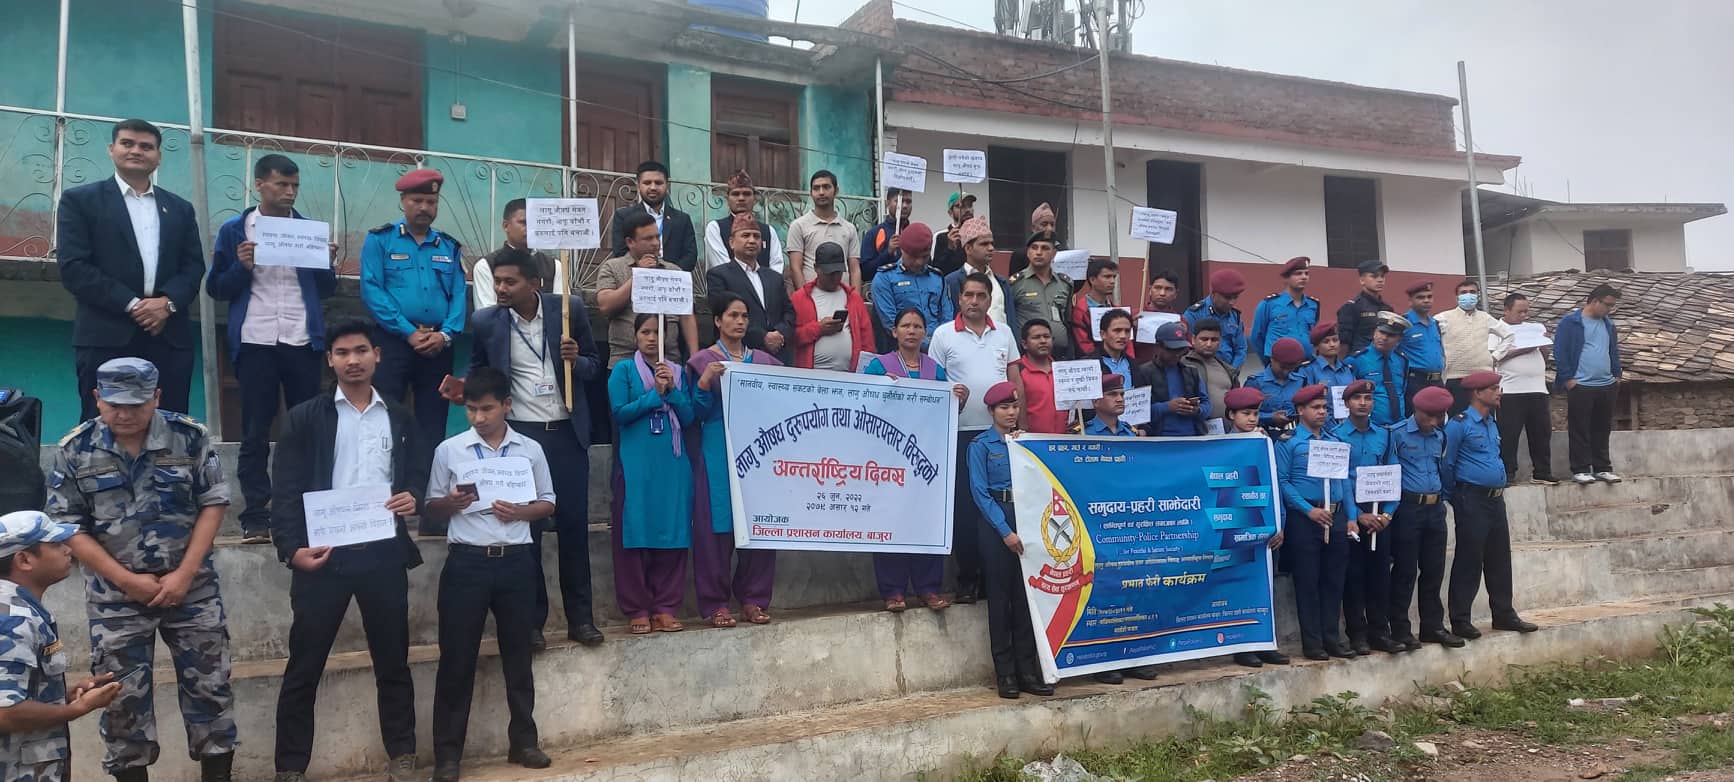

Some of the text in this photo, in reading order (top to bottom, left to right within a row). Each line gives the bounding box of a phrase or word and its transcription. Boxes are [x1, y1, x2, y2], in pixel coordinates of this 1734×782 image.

[735, 444, 761, 479] लागु
[754, 427, 785, 457] औषध
[831, 407, 852, 429] तथा
[865, 460, 906, 487] दिवस
[846, 493, 863, 502] २०२२
[1087, 496, 1201, 517] समुदाय-प्रहरी साझेदारी
[752, 513, 790, 524] आयोजक
[752, 524, 783, 538] जिल्ला
[786, 528, 821, 539] प्रशासन
[867, 531, 893, 543] बाजुरा
[1095, 530, 1200, 545] Community-Police Partnership
[1163, 571, 1208, 587] कार्यक्रम
